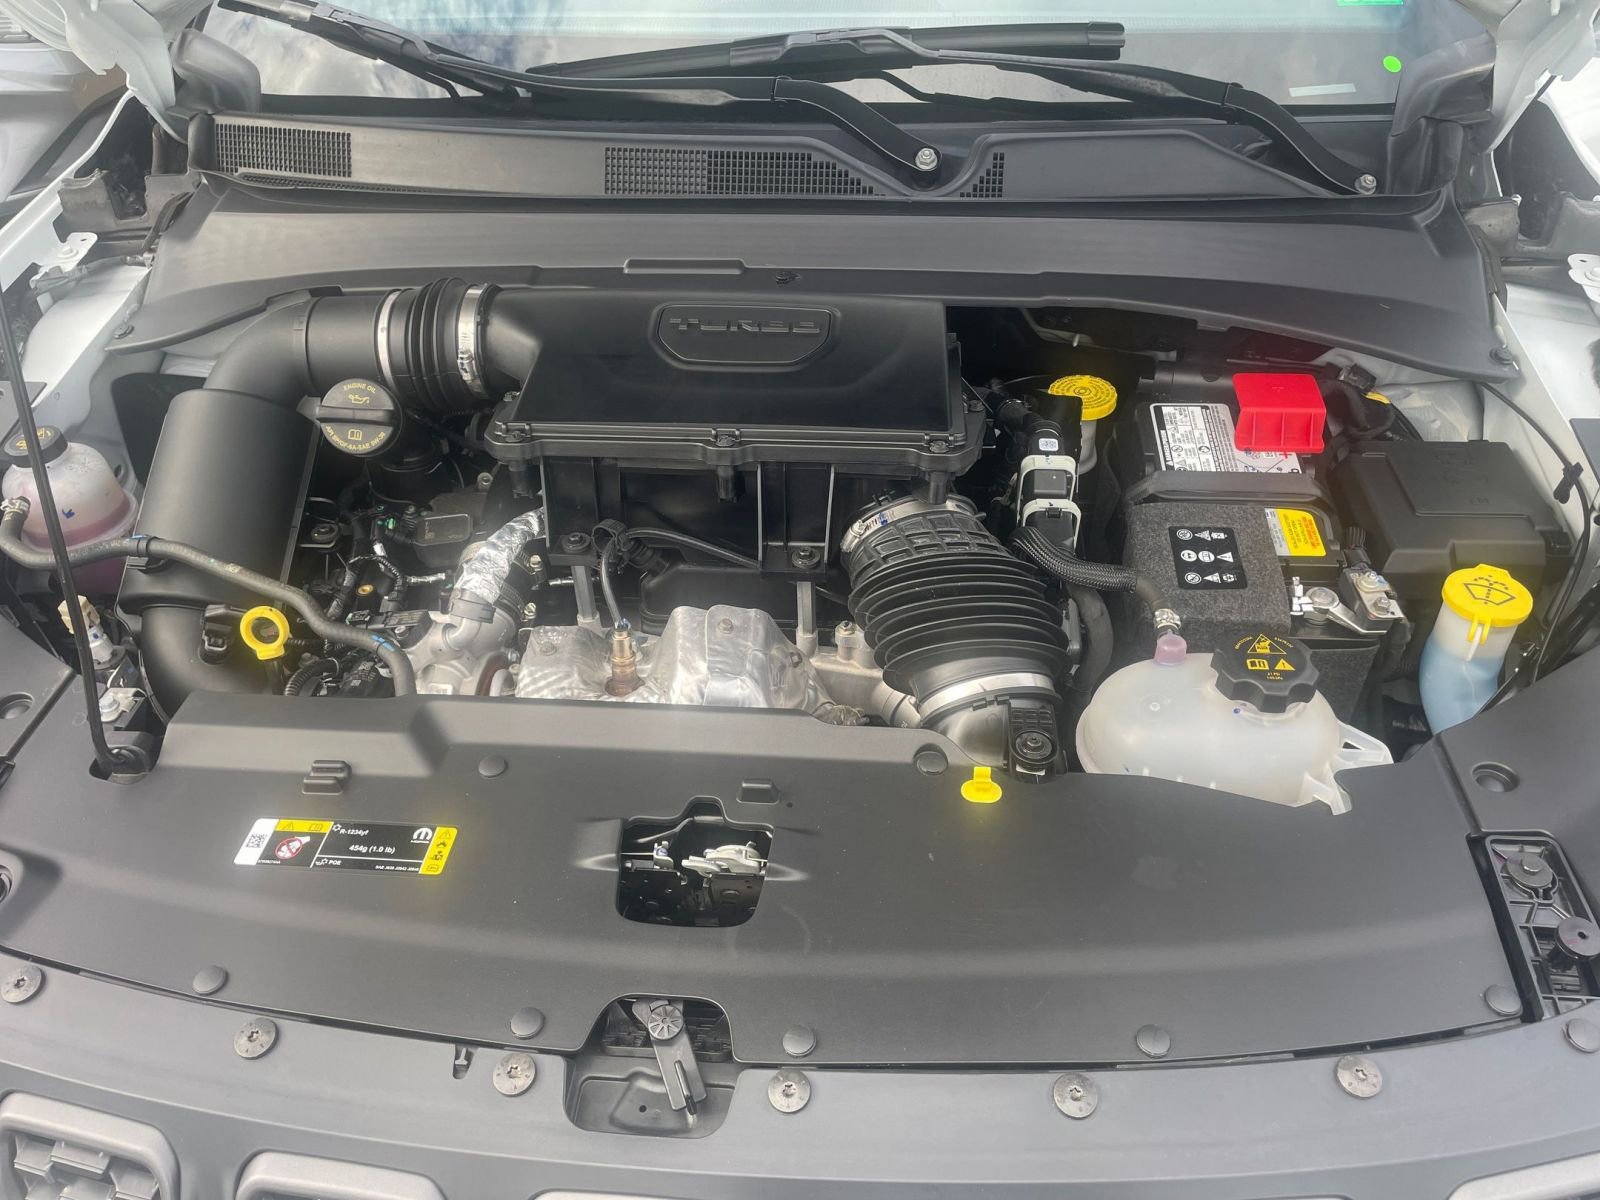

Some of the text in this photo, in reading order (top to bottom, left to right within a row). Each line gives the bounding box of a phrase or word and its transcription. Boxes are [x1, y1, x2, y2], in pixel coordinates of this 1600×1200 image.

[669, 317, 820, 334] TURBO
[343, 382, 376, 394] ENGINE OIL
[340, 828, 369, 836] R-1234yf
[348, 844, 396, 854] 454g (1.0 lb)
